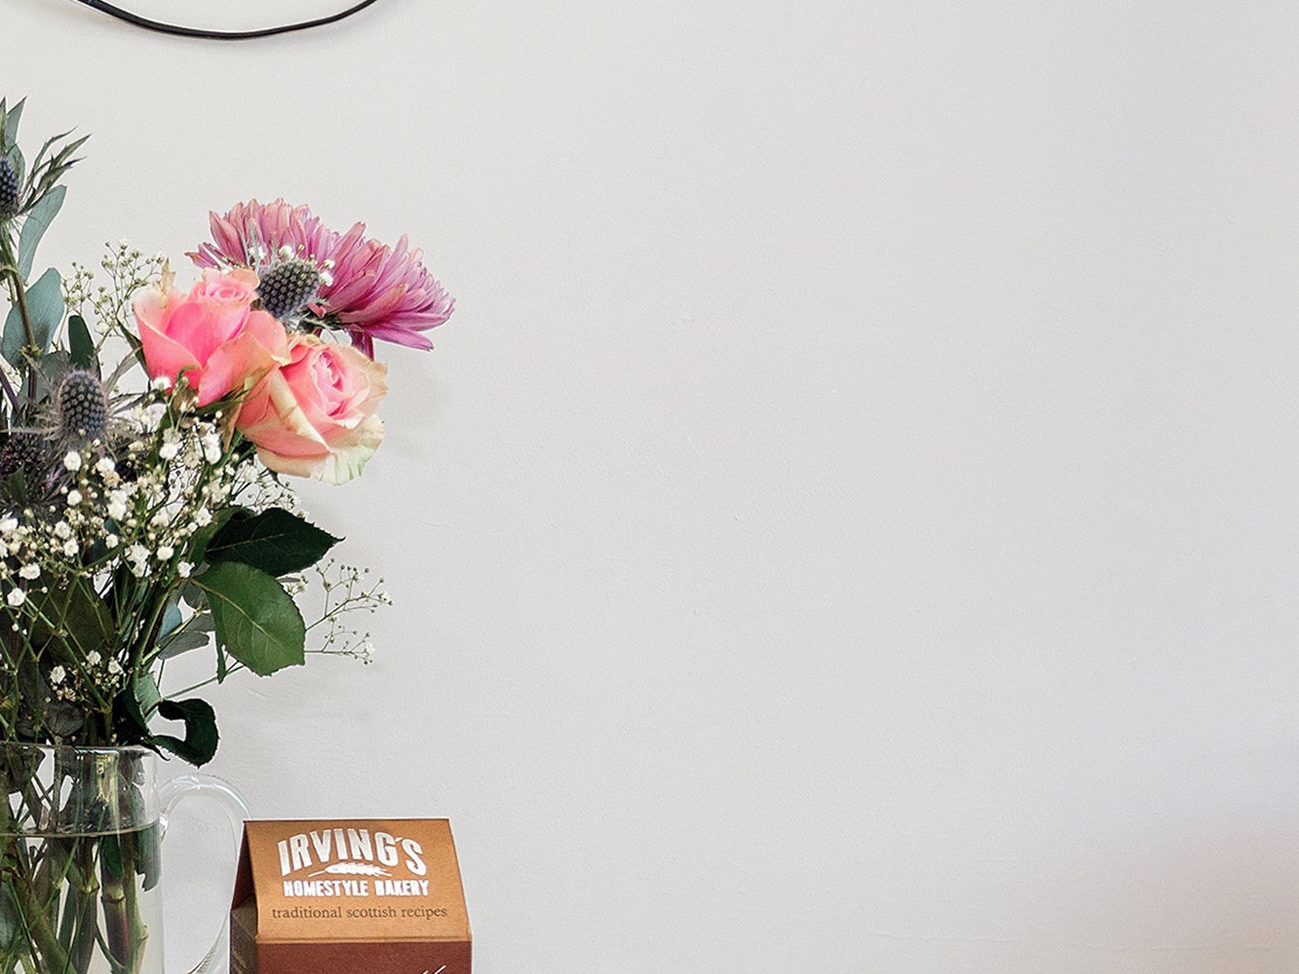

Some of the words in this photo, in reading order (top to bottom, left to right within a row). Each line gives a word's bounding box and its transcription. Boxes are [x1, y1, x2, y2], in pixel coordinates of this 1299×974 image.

[277, 828, 428, 876] IRVING'S
[283, 880, 369, 897] HOMESTYLE
[375, 880, 429, 896] BAKERY
[272, 906, 342, 919] traditional
[346, 905, 397, 918] scottish
[401, 906, 447, 920] recipes
